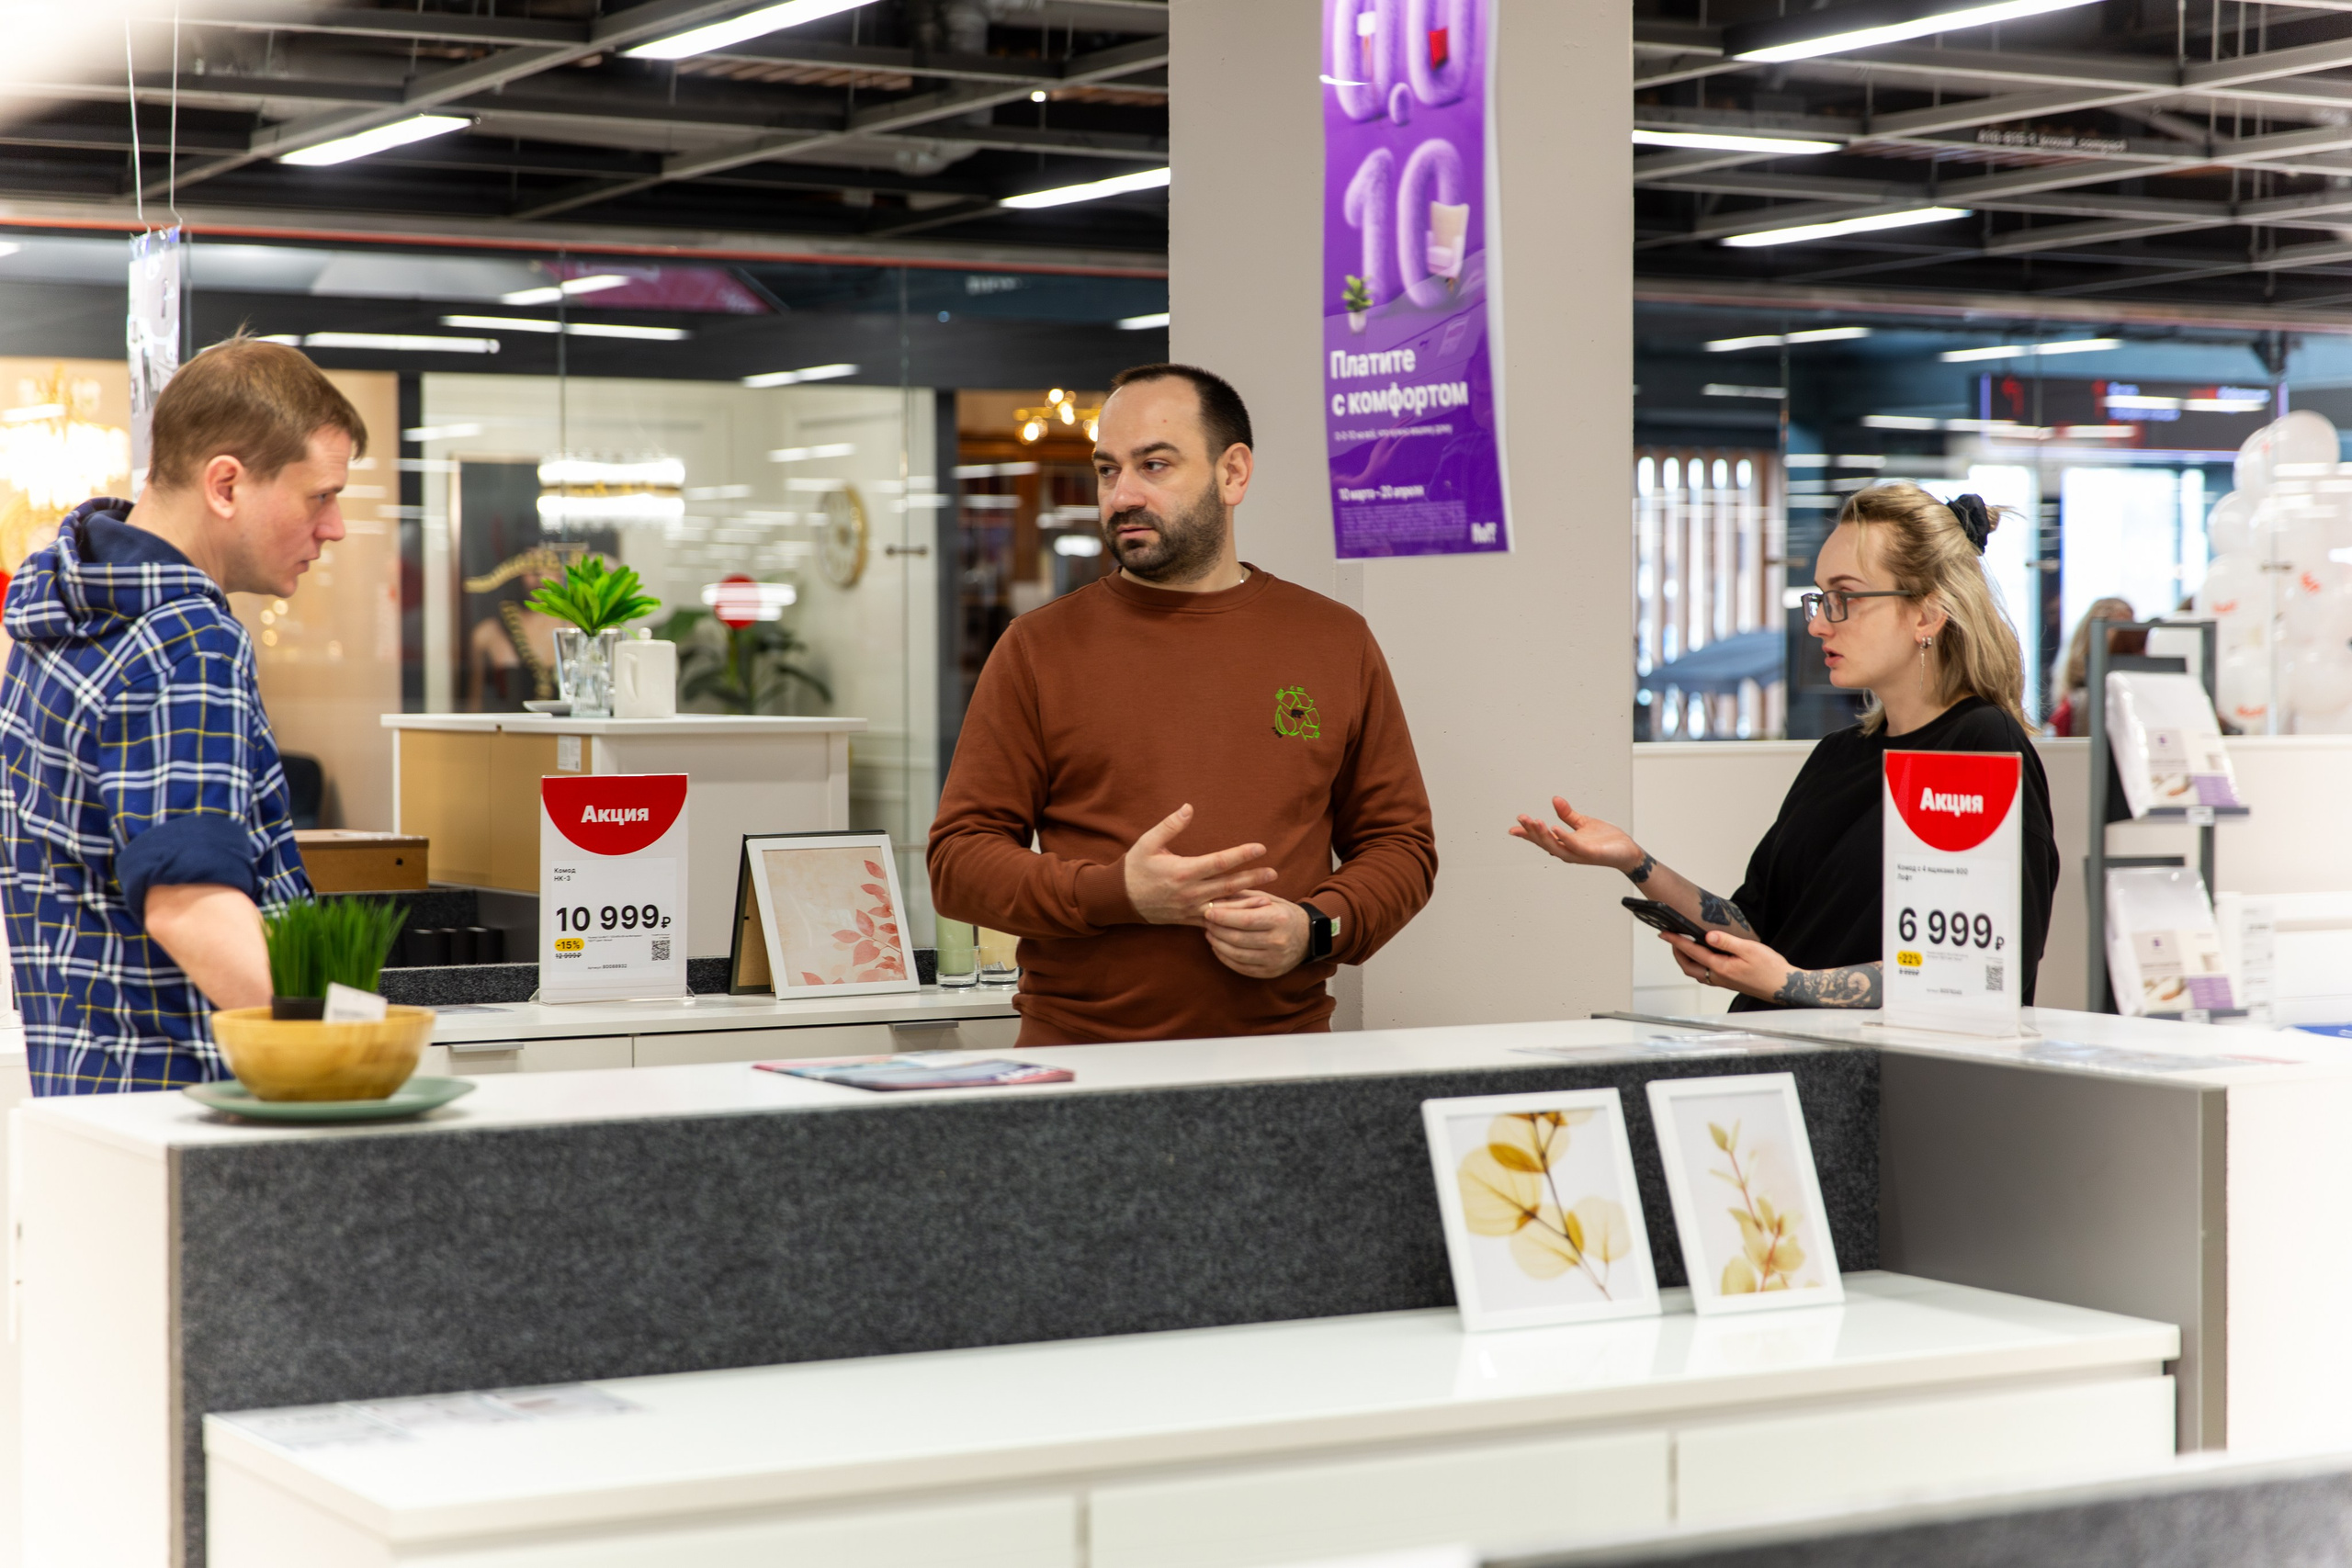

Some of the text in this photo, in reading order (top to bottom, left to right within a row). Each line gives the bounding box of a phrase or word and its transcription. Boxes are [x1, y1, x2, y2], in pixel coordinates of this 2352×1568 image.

[1344, 138, 1465, 310] 10
[1330, 349, 1416, 379] Платите
[1332, 381, 1468, 417] с комфортом
[1338, 488, 1350, 502] 10
[1351, 488, 1375, 503] марта
[1393, 485, 1424, 501] апреля
[581, 805, 650, 826] Акция
[1919, 787, 1984, 818] Акция
[556, 907, 590, 931] 10
[1898, 906, 1917, 942] 6
[556, 941, 581, 950] -15%
[1898, 953, 1921, 965] -22%
